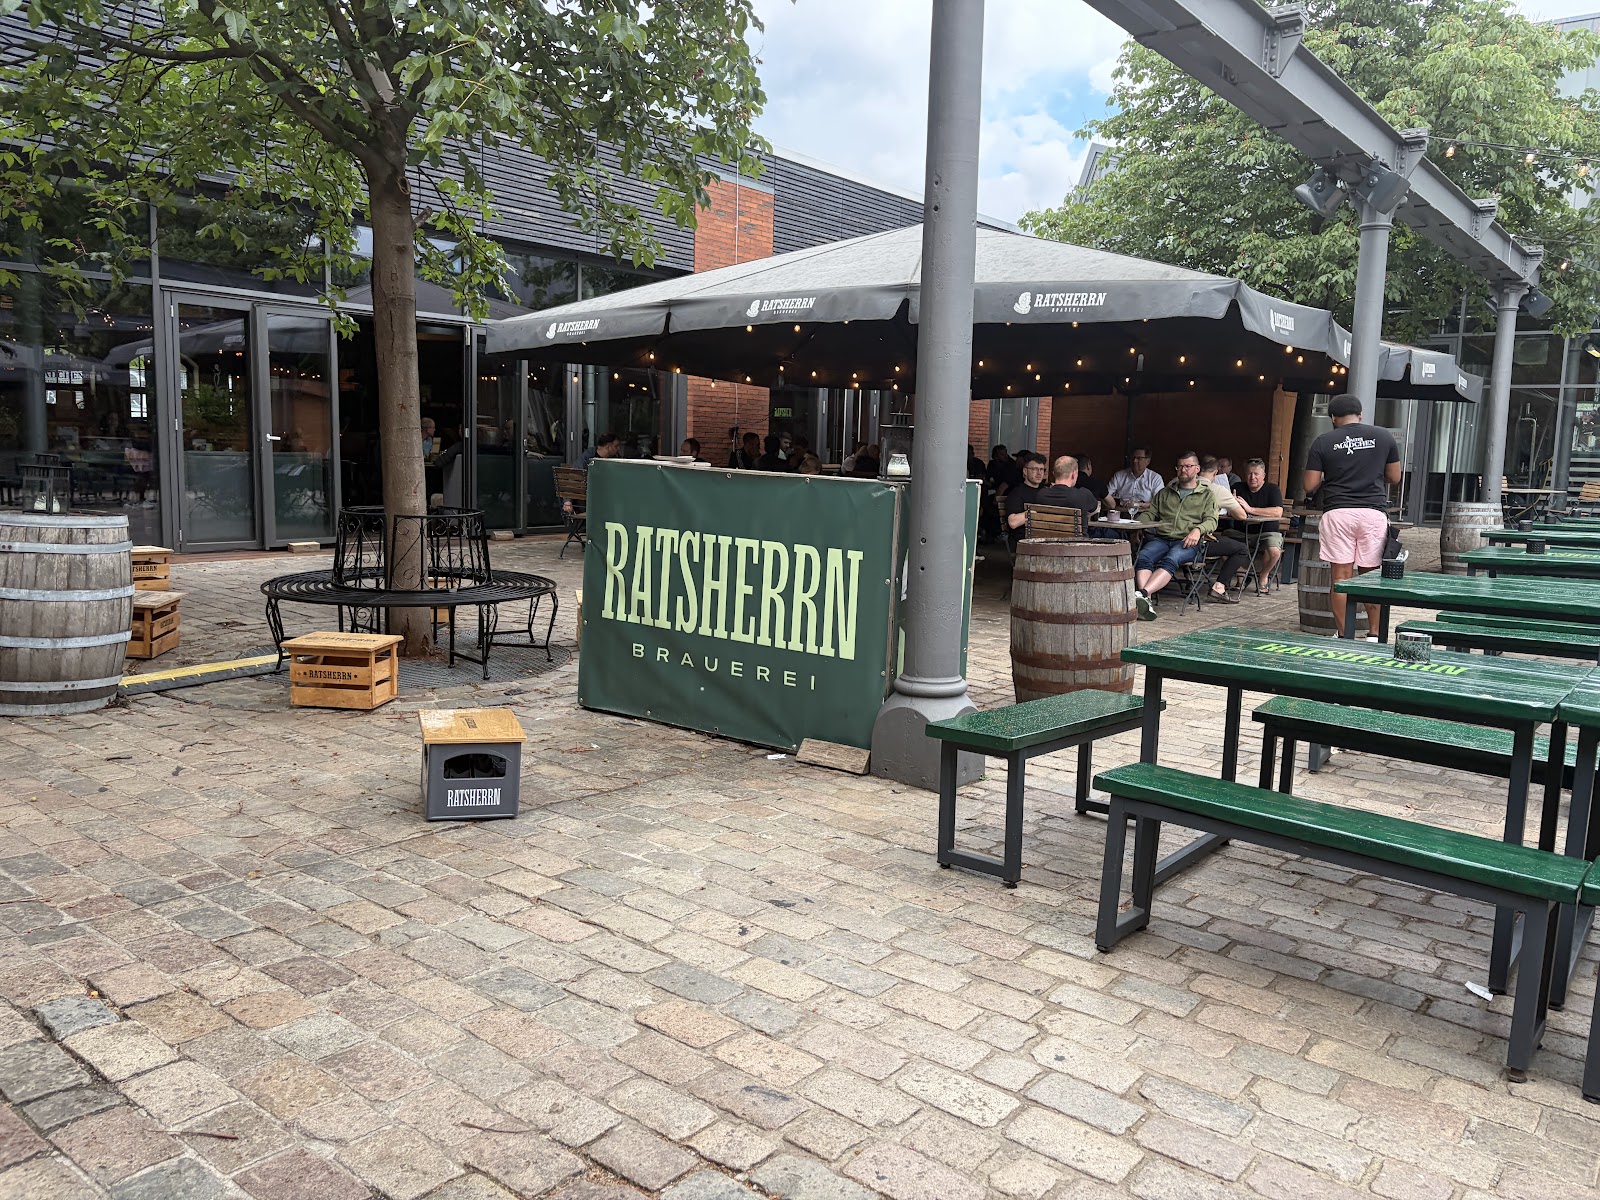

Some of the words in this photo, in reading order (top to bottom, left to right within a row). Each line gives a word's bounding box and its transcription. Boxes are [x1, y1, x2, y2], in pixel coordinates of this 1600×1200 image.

[760, 297, 817, 312] RATSHERRN
[1033, 292, 1108, 308] RATSHERRN
[556, 318, 601, 333] RATSHERRN
[132, 565, 158, 573] TSHERRN
[601, 521, 864, 661] RATSHERRN
[632, 642, 816, 691] BRAUEREI
[308, 669, 352, 681] RATSHERRN
[446, 787, 502, 808] RATSHERRN
